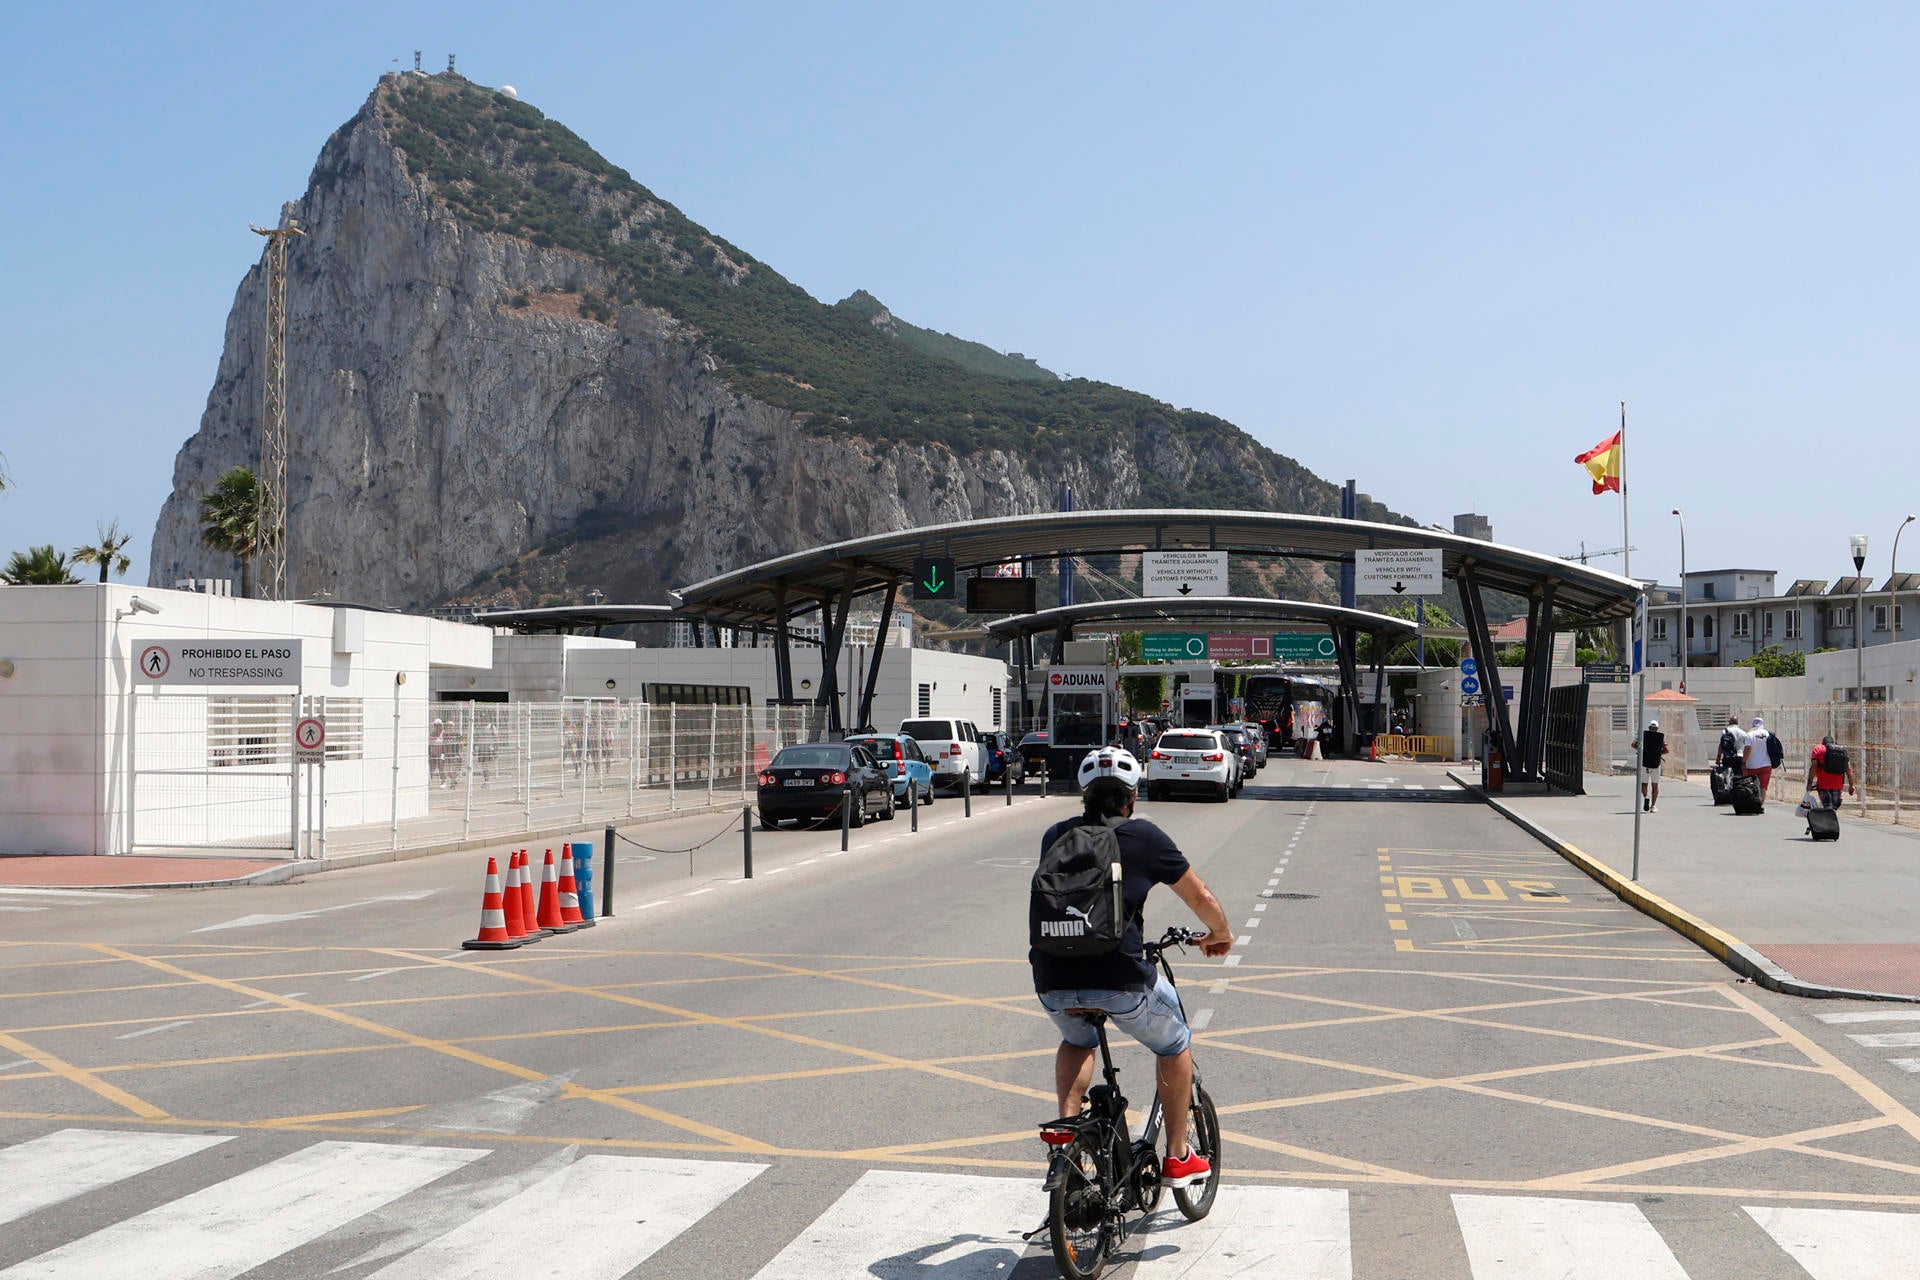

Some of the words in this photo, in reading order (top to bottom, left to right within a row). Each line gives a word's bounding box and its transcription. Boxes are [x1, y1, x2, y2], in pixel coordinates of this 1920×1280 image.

[182, 649, 242, 659] PROHIBIDO
[245, 649, 258, 659] EL
[261, 649, 290, 659] PASO
[189, 668, 205, 678] NO
[208, 668, 283, 678] TRESPASSING
[1062, 674, 1104, 686] ADUANA
[1396, 876, 1572, 903] BUS
[1040, 920, 1084, 937] PUMA
